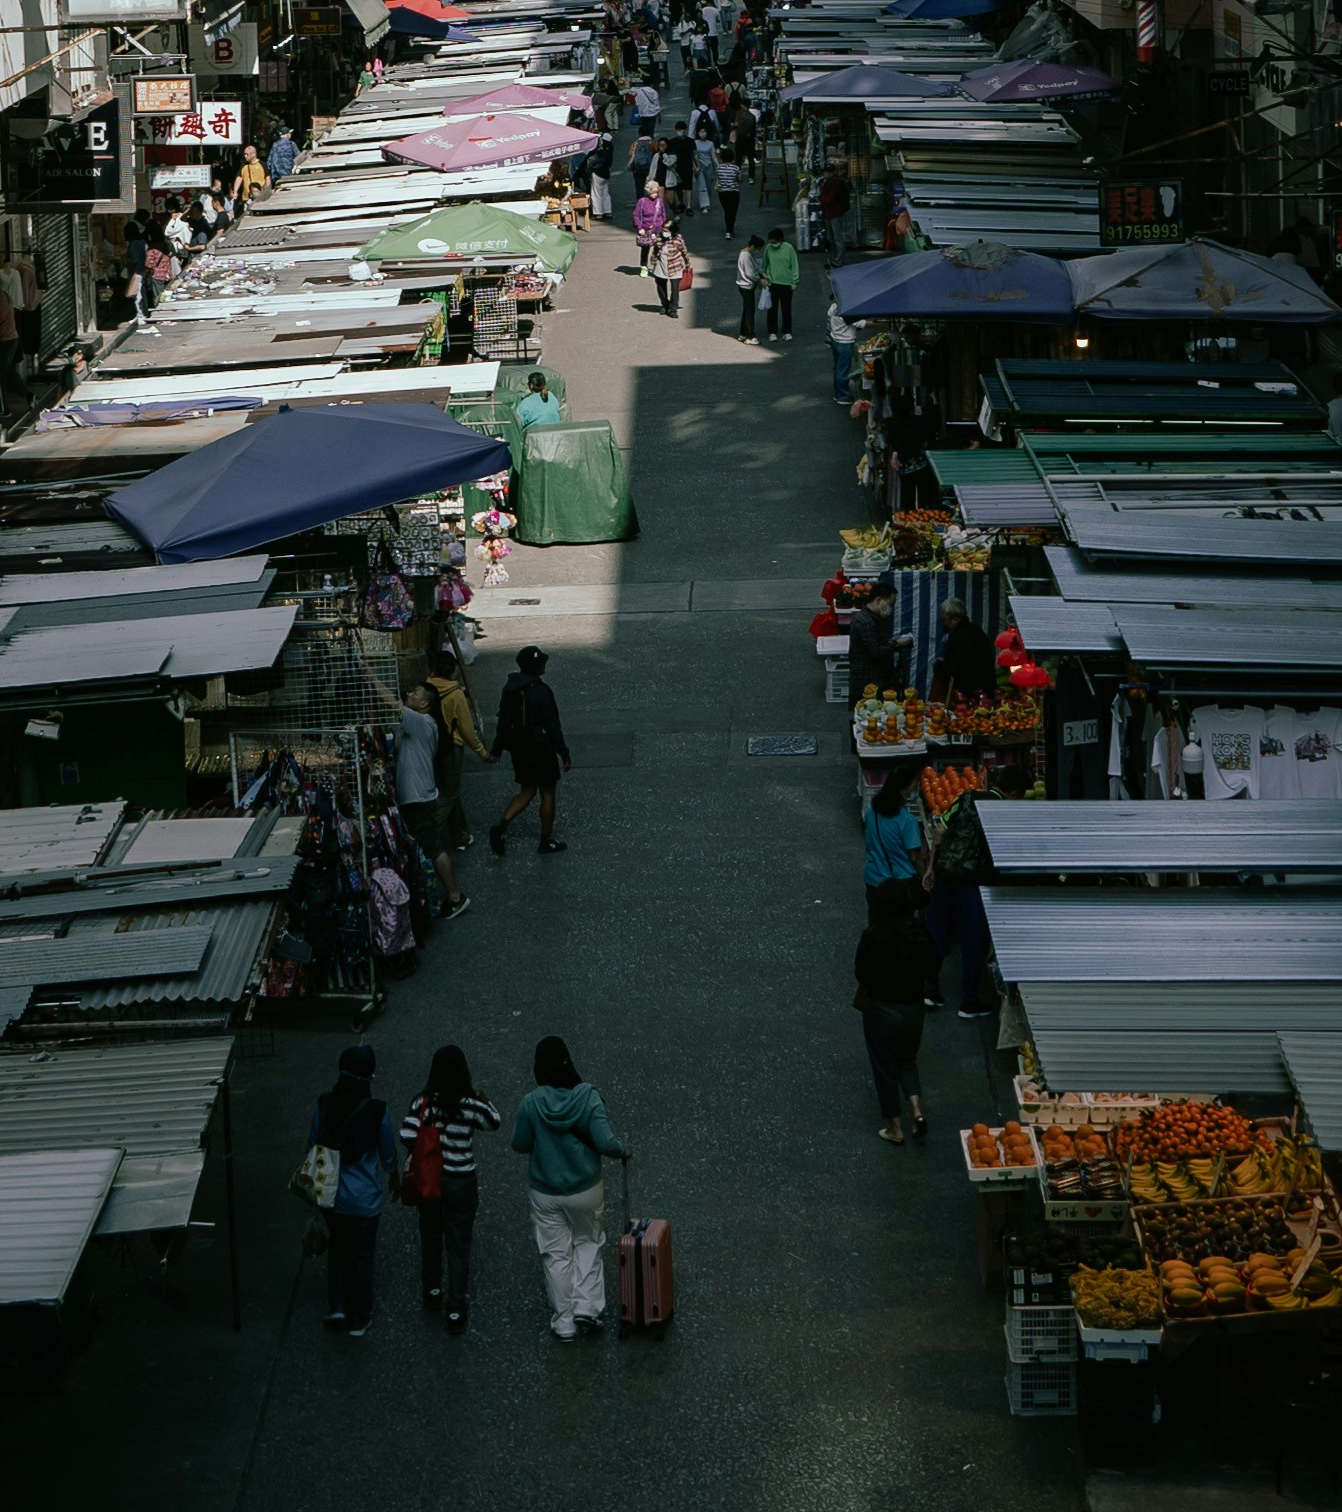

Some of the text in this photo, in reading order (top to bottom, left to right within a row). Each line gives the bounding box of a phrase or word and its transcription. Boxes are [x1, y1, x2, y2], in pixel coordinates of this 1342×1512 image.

[1210, 78, 1247, 92] CYCLE
[495, 129, 542, 144] Yedpay
[66, 168, 103, 178] SALON
[1107, 223, 1178, 240] 91755993
[1211, 733, 1251, 745] HONG
[1212, 745, 1251, 756] KONG
